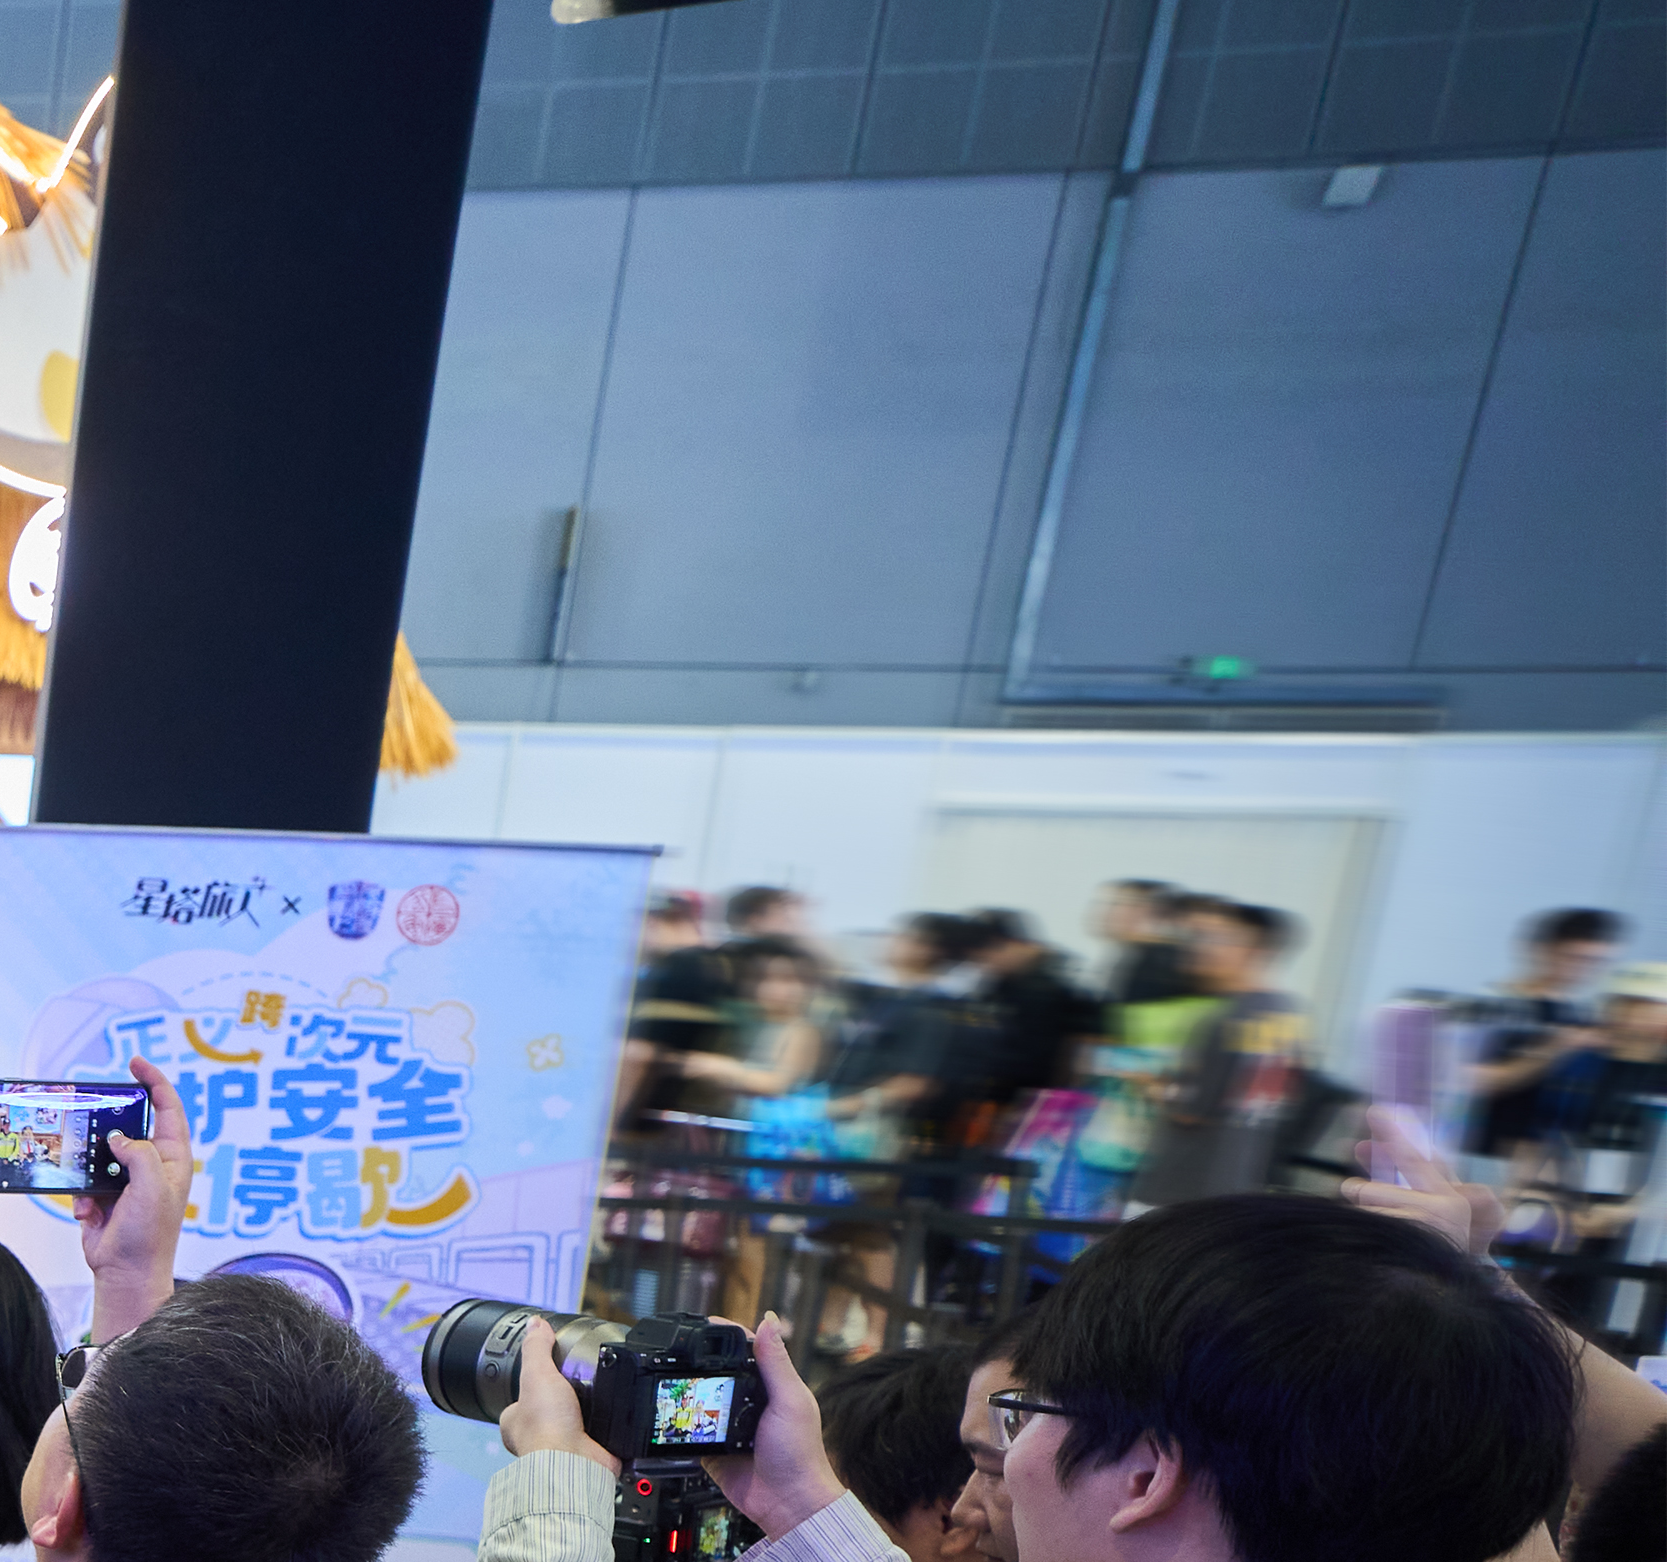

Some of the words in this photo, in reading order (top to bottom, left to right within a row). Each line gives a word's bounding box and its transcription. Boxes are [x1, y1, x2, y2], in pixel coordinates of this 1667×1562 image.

[75, 1058, 464, 1144] 护安全
[181, 1144, 472, 1231] 停歇
